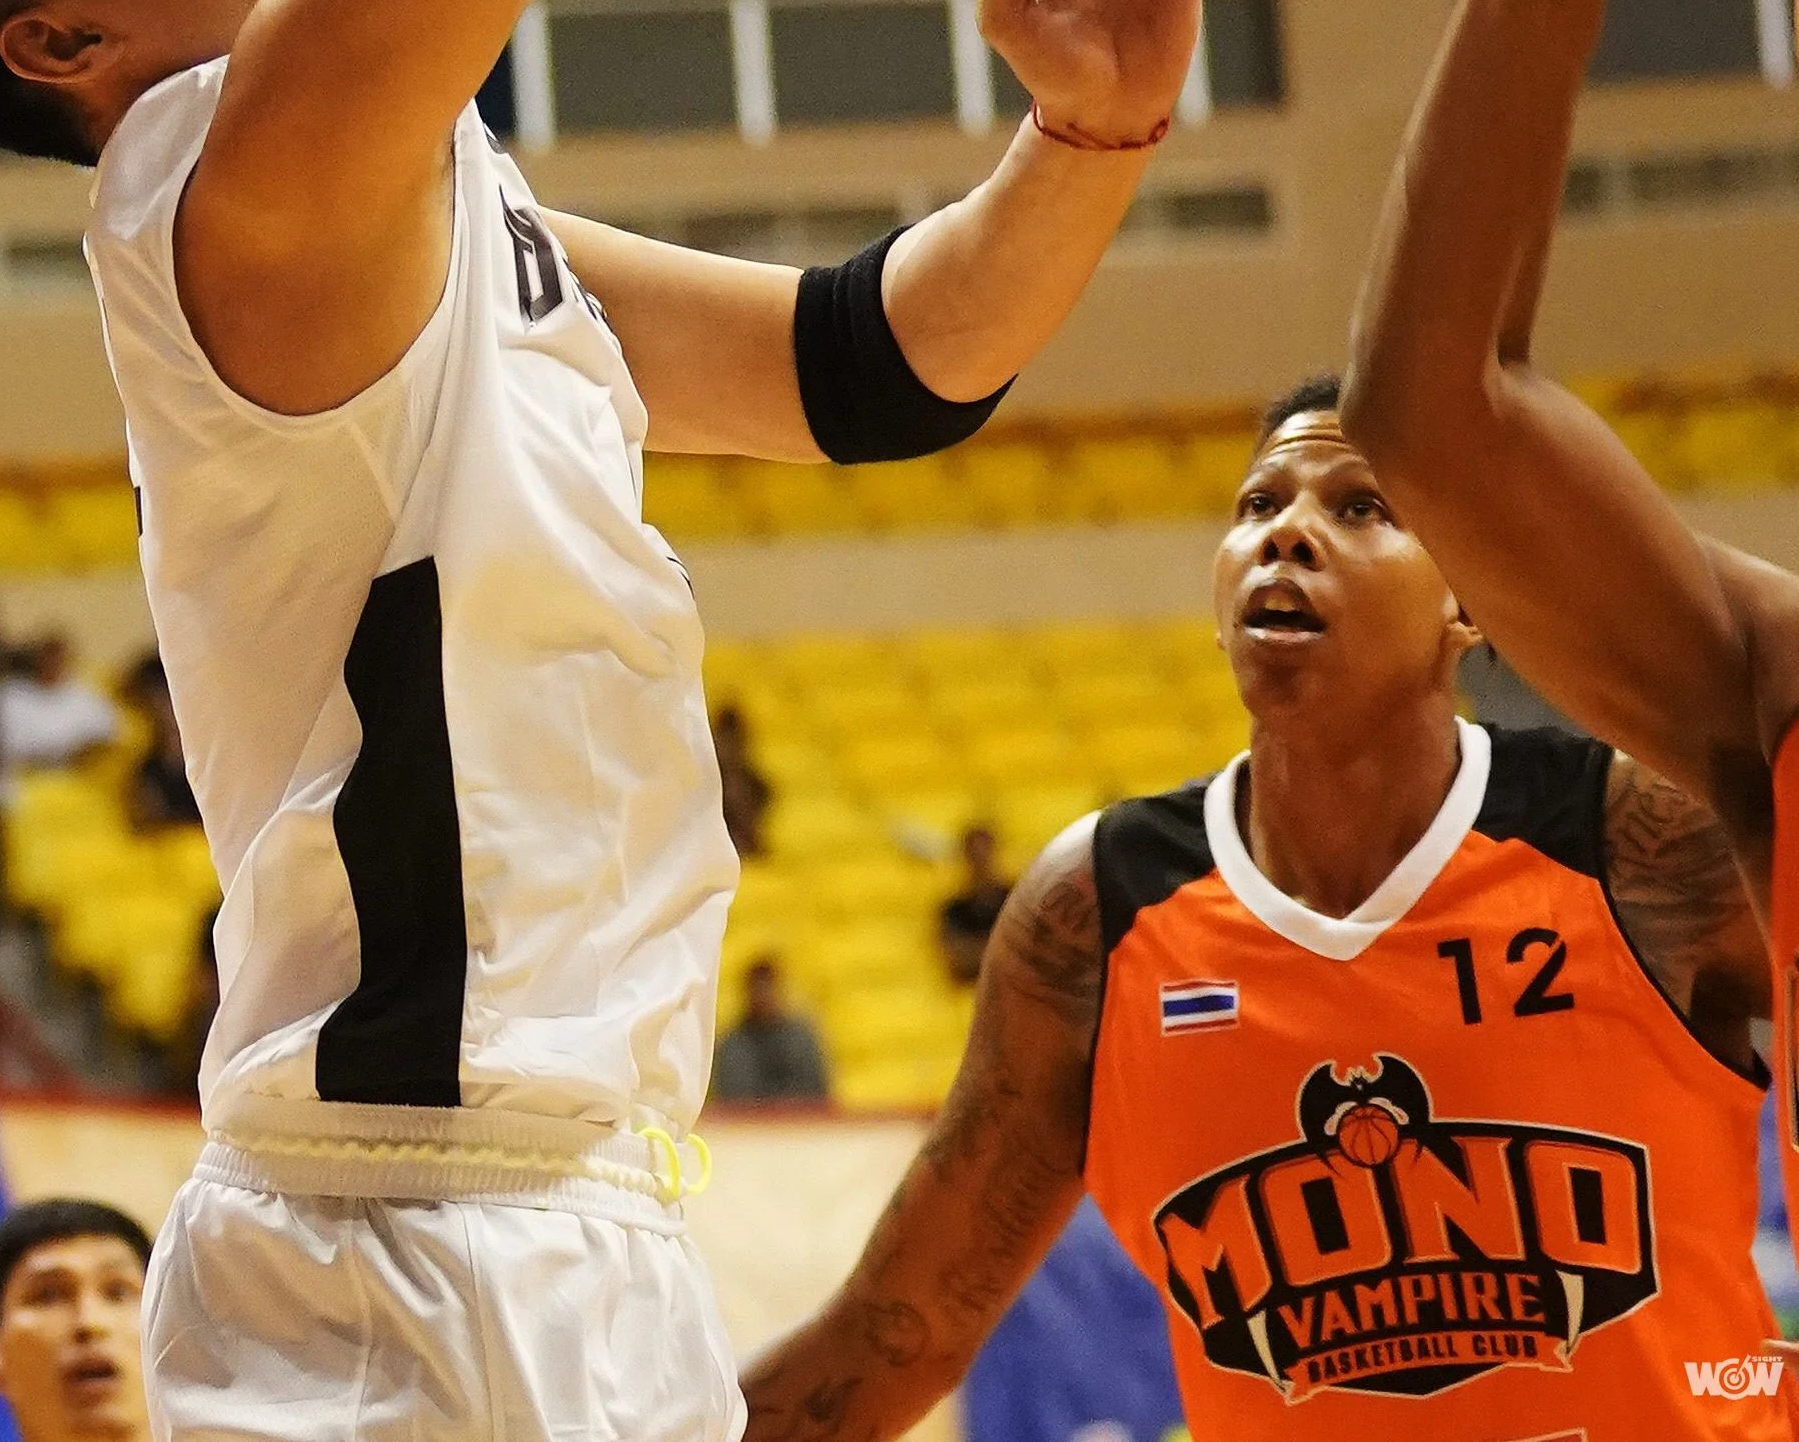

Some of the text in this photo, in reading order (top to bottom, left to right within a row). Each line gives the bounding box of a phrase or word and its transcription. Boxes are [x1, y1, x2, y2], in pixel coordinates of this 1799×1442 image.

[1437, 927, 1575, 1025] 12
[1159, 1136, 1641, 1328] MONO
[1277, 1270, 1546, 1348] VAMPIRE
[1307, 1333, 1538, 1384] BASKETBALL CLUB
